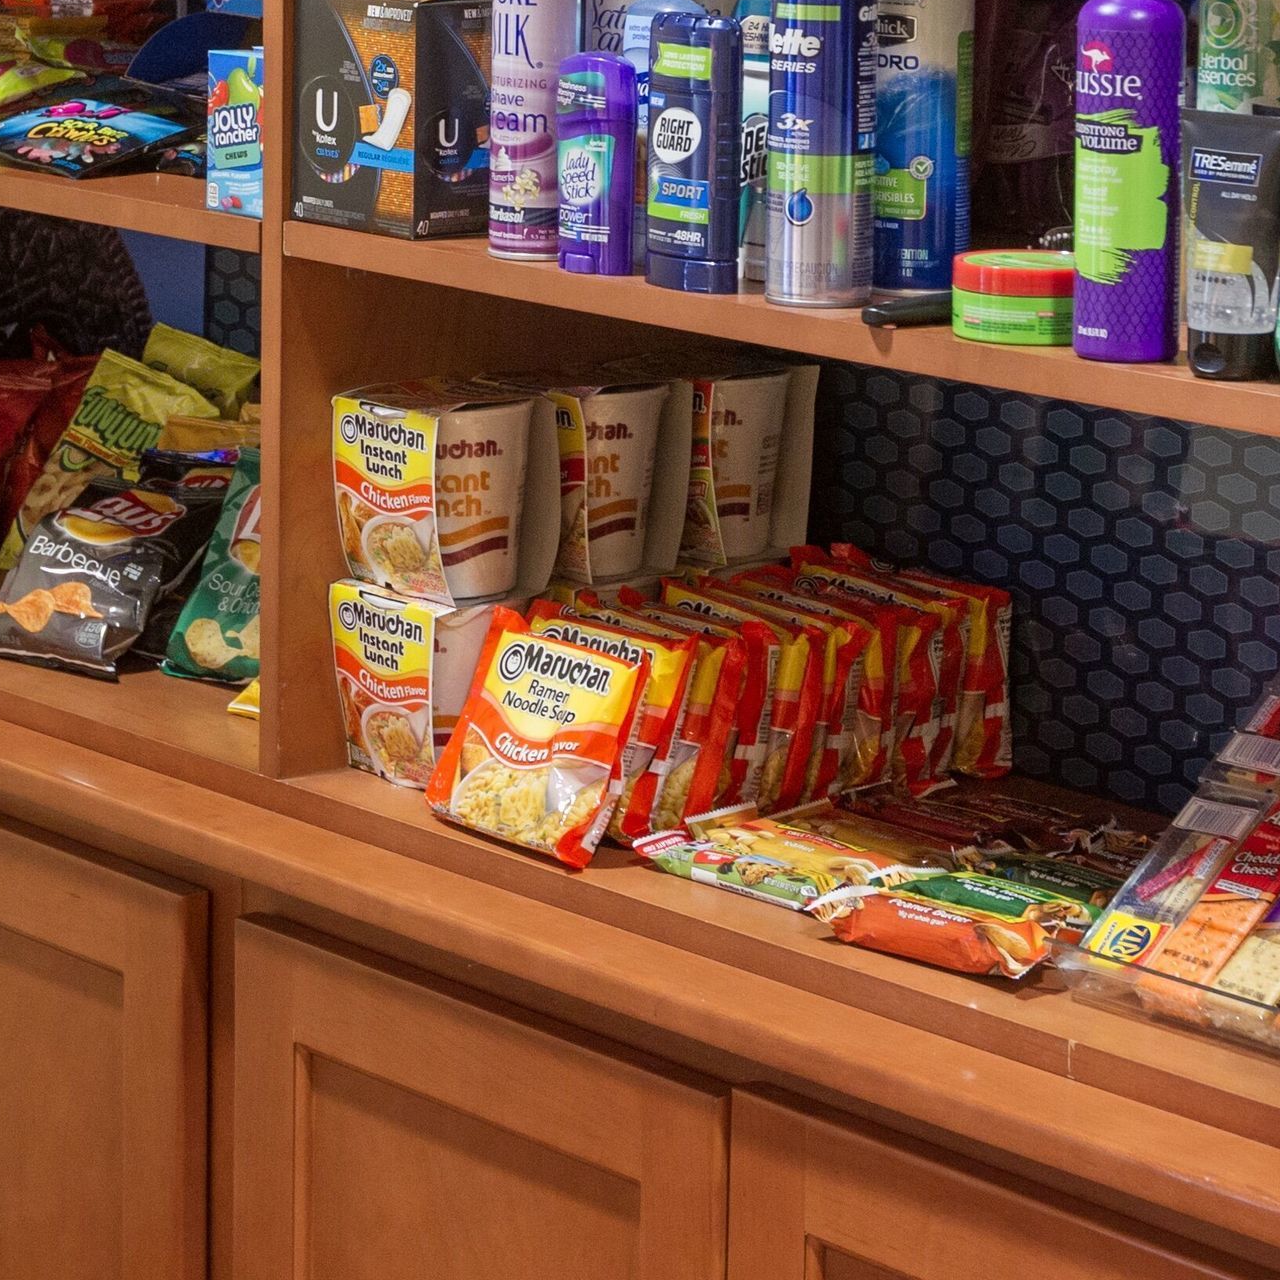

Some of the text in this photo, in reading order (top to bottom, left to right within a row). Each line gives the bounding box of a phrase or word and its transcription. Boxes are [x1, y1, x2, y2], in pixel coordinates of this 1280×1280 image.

[876, 19, 908, 35] hick
[492, 9, 535, 70] ILK
[768, 22, 822, 57] lette
[771, 59, 817, 74] SERIES
[877, 53, 919, 71] DRO
[1199, 53, 1248, 70] Herbal
[493, 75, 548, 90] TURIZING
[212, 105, 254, 133] JOLLY
[315, 88, 338, 132] U
[438, 118, 459, 148] U
[491, 111, 548, 134] ream
[659, 116, 694, 137] RIGHT
[1076, 124, 1126, 137] DSTRONG
[214, 128, 258, 147] rancher
[316, 131, 337, 146] Kotex
[656, 132, 694, 153] GUARD
[224, 150, 248, 161] CHEWS
[357, 151, 381, 162] REGULAR
[439, 147, 458, 156] Kotex
[565, 151, 590, 170] lady
[1194, 152, 1257, 174] TRESemmé
[560, 163, 597, 187] Speed
[872, 176, 898, 188] SITIVE
[564, 182, 594, 201] Stick
[661, 182, 705, 201] SPORT
[1189, 183, 1200, 219] CONTROL
[294, 202, 304, 218] 40
[559, 208, 588, 223] power
[679, 210, 705, 221] FRESH
[354, 414, 428, 452] Maruchan
[360, 438, 408, 465] Instant
[436, 438, 497, 460] uchan
[365, 457, 403, 482] Lunch
[436, 470, 491, 494] tant
[360, 481, 432, 510] Chicken Flavor
[436, 494, 483, 518] nch
[29, 535, 122, 589] Barbecue
[208, 573, 246, 595] Sour
[218, 597, 230, 612] &
[353, 602, 424, 643] Maruchan
[358, 628, 405, 657] Instant
[363, 646, 399, 672] Lunch
[524, 642, 610, 694] Maruchan
[358, 669, 428, 699] Chicken Flavor
[502, 690, 576, 726] Noodle Soup
[493, 731, 549, 763] Chicken
[1231, 862, 1279, 877] Cheese
[889, 897, 973, 925] Peanut Butter
[1110, 924, 1148, 960] RITZ
